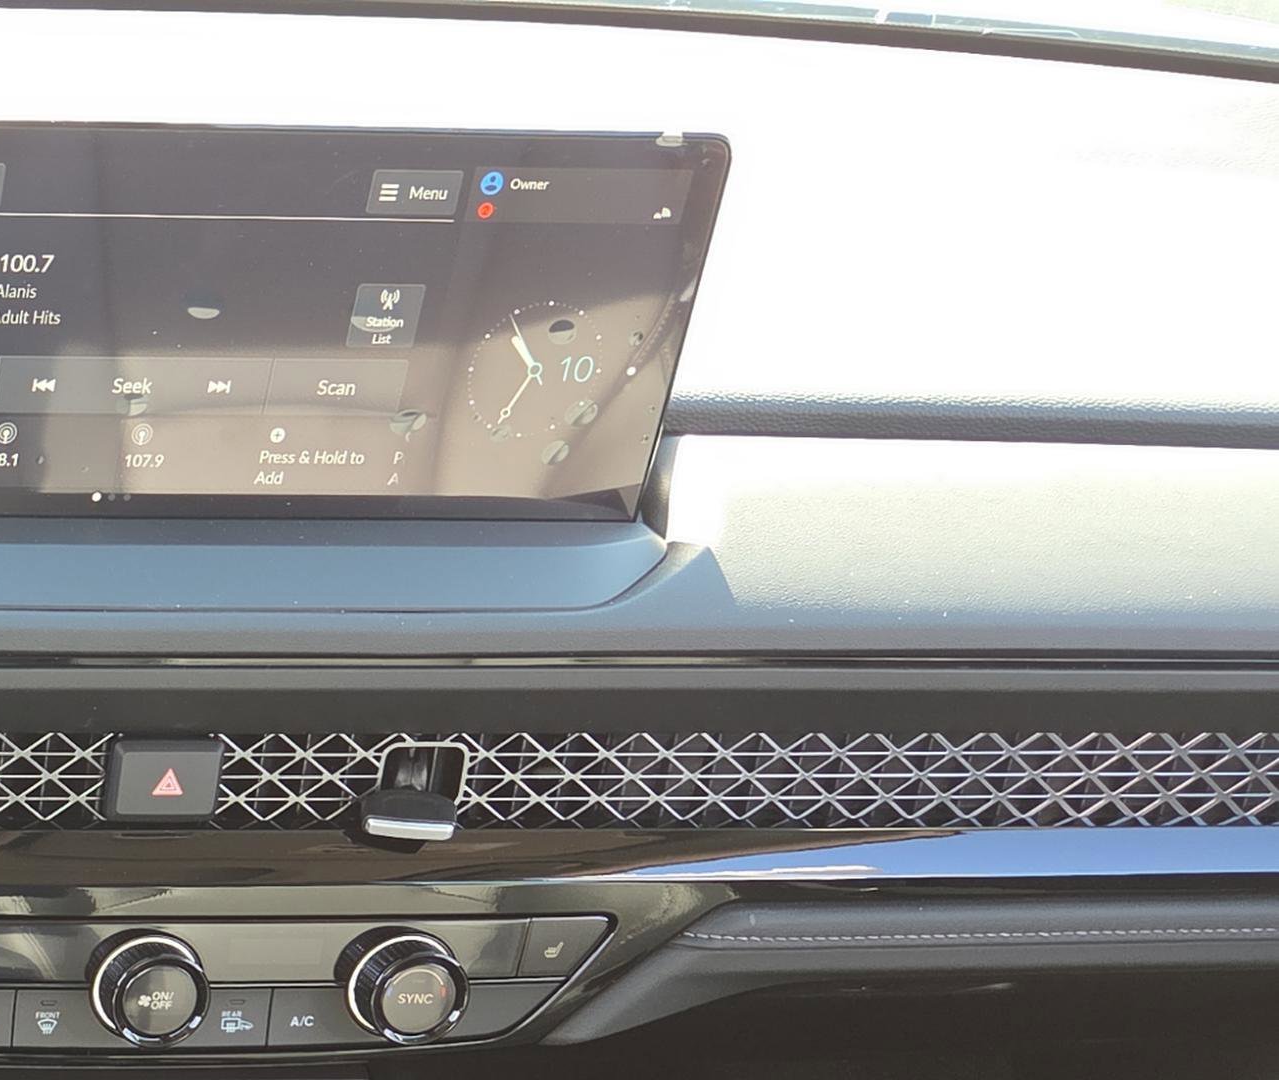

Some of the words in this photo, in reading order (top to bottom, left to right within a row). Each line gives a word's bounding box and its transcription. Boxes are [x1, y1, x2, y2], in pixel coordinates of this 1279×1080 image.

[510, 178, 549, 191] Owner
[409, 185, 448, 201] Menu
[0, 254, 54, 273] 100.7
[32, 309, 61, 326] Hits
[365, 315, 404, 328] Station
[371, 333, 391, 345] List
[560, 356, 594, 382] 10
[112, 377, 152, 395] Seek
[316, 379, 356, 397] Scan
[124, 453, 164, 468] 107.9
[259, 450, 296, 465] Press
[299, 450, 310, 464] &
[313, 450, 346, 465] Hold
[350, 451, 365, 465] to
[254, 470, 284, 485] Add
[152, 991, 175, 1002] ON/
[398, 992, 434, 1006] SYNC
[151, 1000, 173, 1011] OFF
[35, 1011, 61, 1019] FRONT
[290, 1014, 314, 1027] A/C
